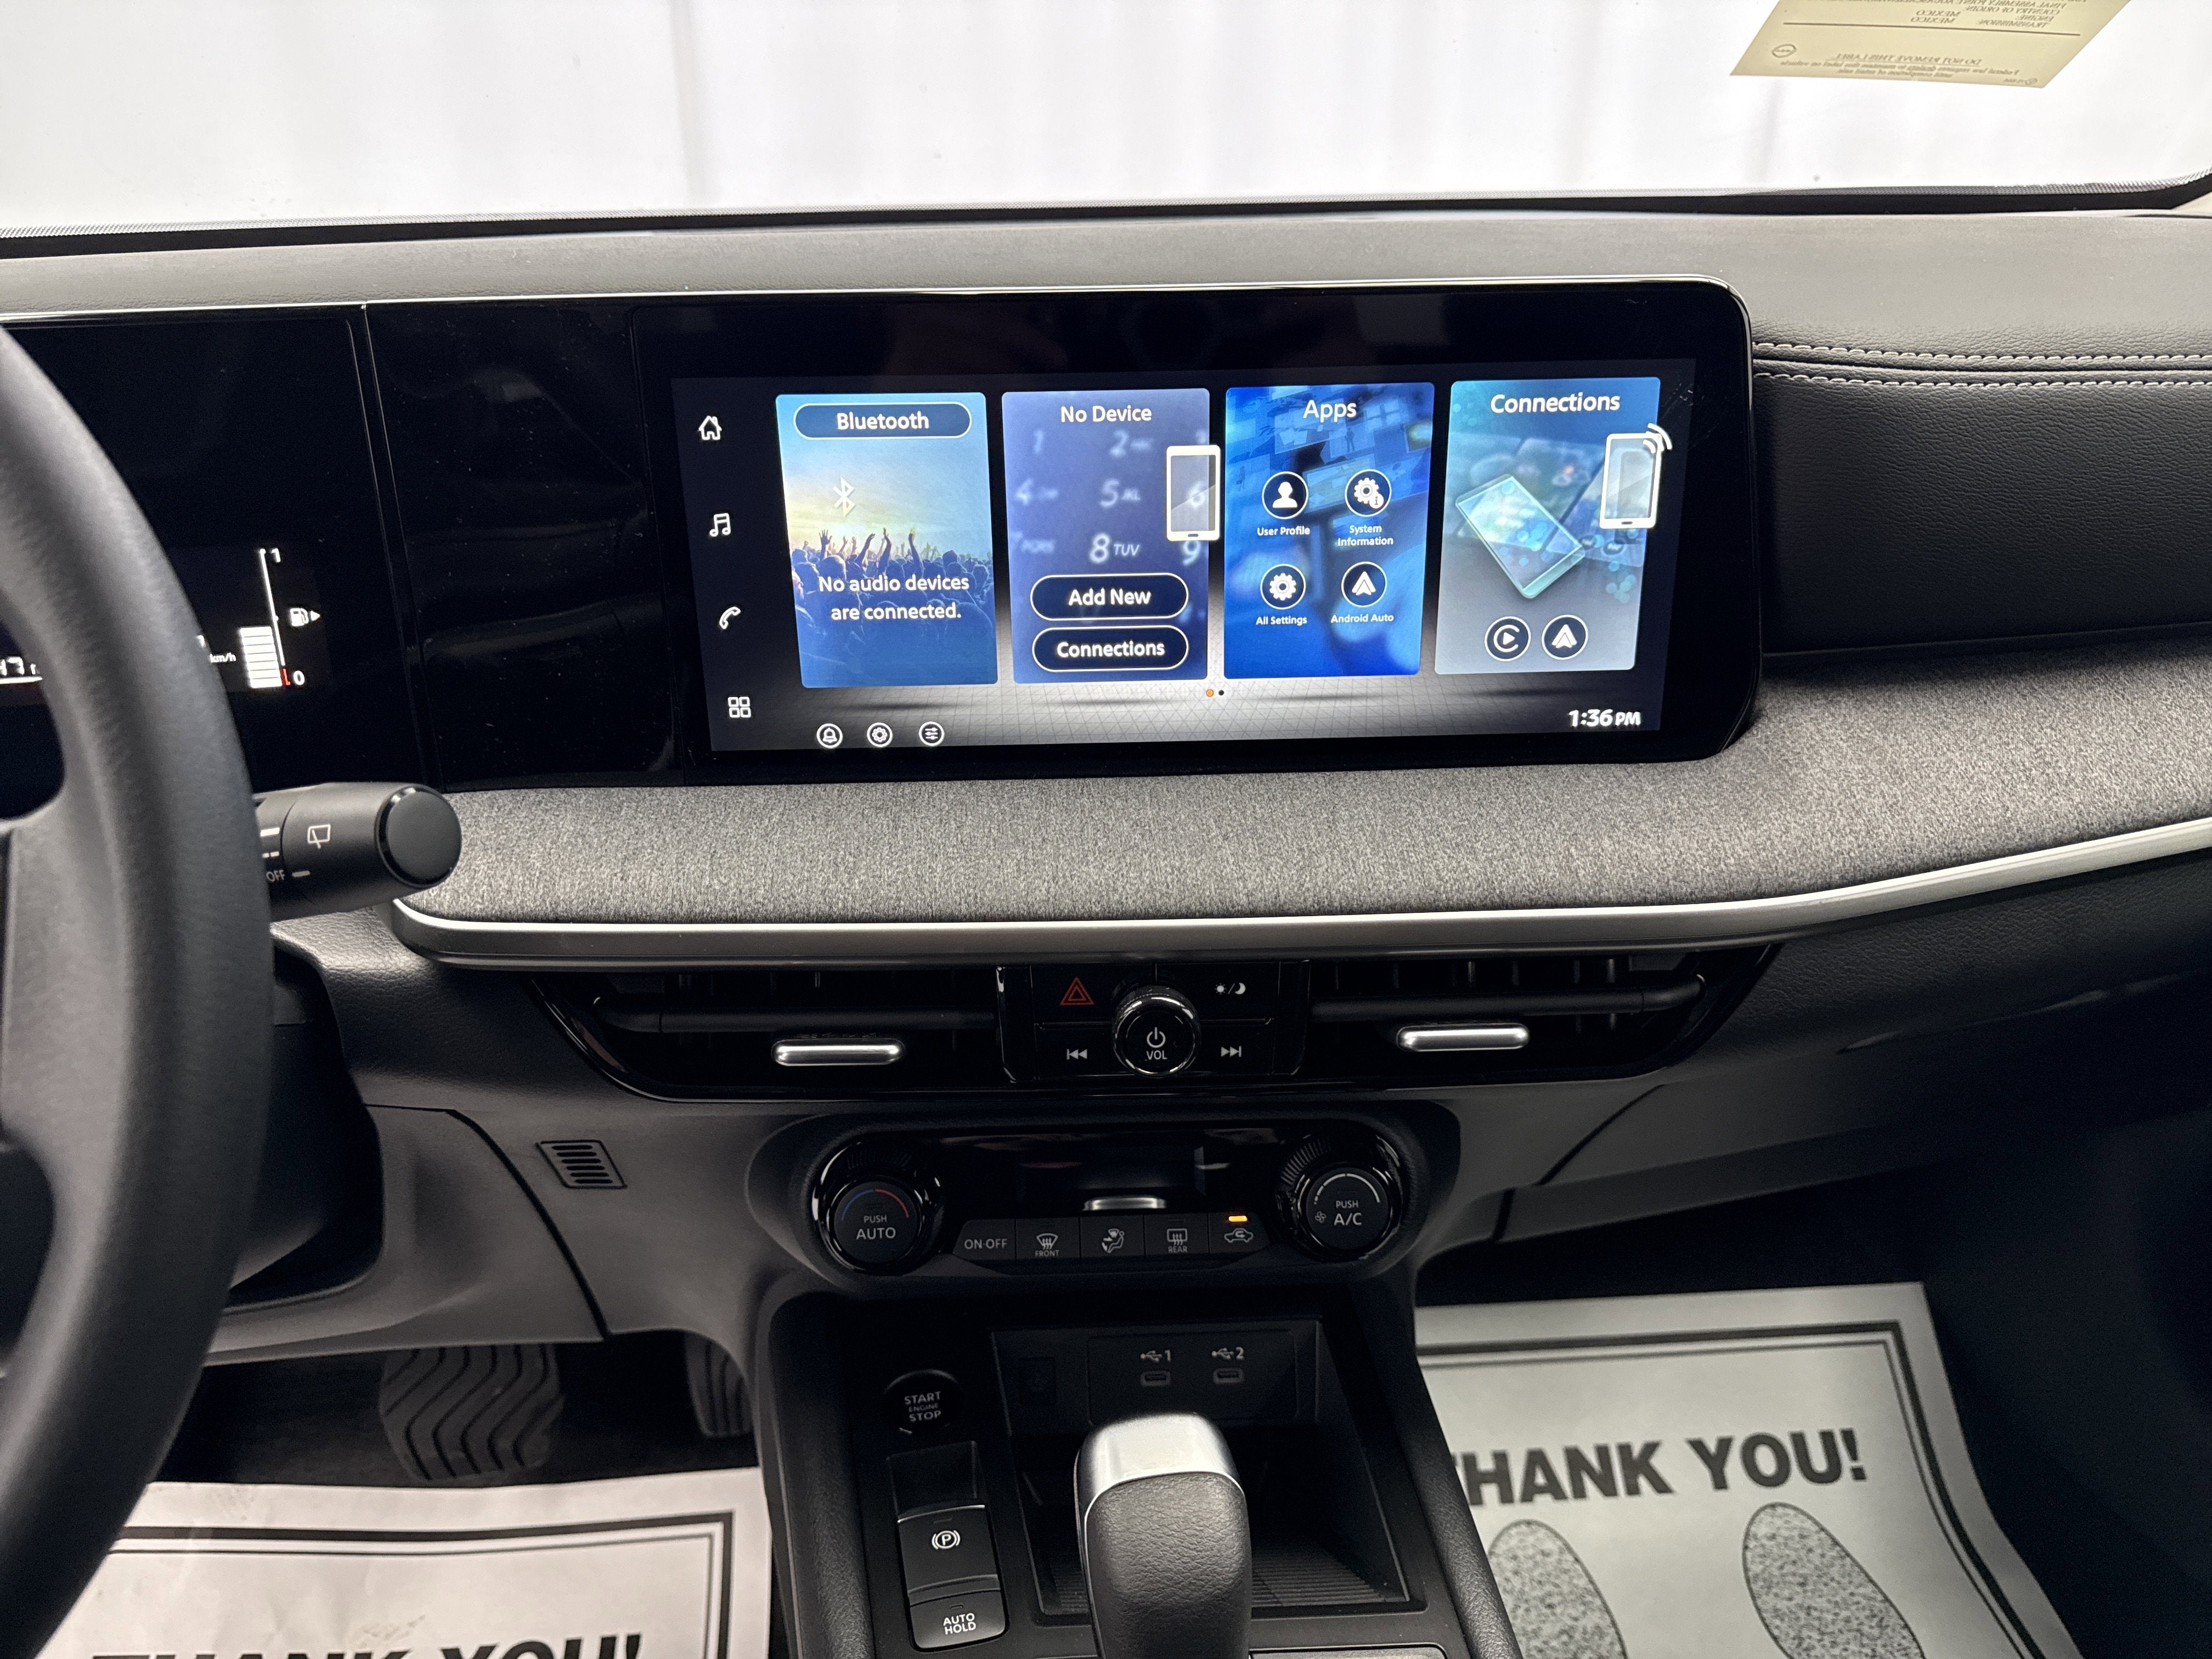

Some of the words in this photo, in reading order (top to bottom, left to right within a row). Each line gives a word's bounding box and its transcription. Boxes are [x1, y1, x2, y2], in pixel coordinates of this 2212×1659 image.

[1303, 400, 1357, 422] Apps
[1490, 393, 1620, 415] Connections
[836, 410, 930, 431] Bluetooth
[1060, 405, 1088, 424] No
[1092, 404, 1153, 423] Device
[1257, 527, 1278, 536] User
[1280, 526, 1311, 535] Profile
[1349, 524, 1383, 535] System
[1089, 532, 1111, 565] 8
[1113, 543, 1141, 557] TUV
[1338, 537, 1394, 547] Information
[818, 575, 845, 593] No
[849, 575, 901, 593] audio
[905, 573, 970, 591] devices
[1068, 589, 1107, 607] Add
[1110, 589, 1152, 606] New
[831, 606, 861, 621] are
[865, 602, 963, 621] connected.
[1256, 616, 1268, 625] All
[1271, 616, 1308, 626] Settings
[1330, 614, 1369, 624] Android
[1370, 614, 1395, 623] Auto
[1056, 640, 1166, 659] Connections
[209, 652, 236, 663] km/h
[293, 670, 305, 685] 0
[266, 870, 286, 883] OFF
[1146, 1049, 1167, 1060] VOL
[1335, 1200, 1359, 1209] PUSH
[864, 1214, 888, 1224] PUSH
[1334, 1212, 1362, 1226] A/C
[856, 1227, 896, 1240] AUTO
[1035, 1250, 1060, 1258] FRONT
[1168, 1245, 1188, 1254] REAR
[904, 1391, 942, 1406] START
[908, 1402, 939, 1413] ENGINE
[908, 1409, 942, 1423] STOP
[1451, 1441, 1675, 1505] HANK
[1686, 1428, 1868, 1491] YOU!
[943, 1612, 975, 1627] AUTO
[944, 1621, 977, 1635] HOLD
